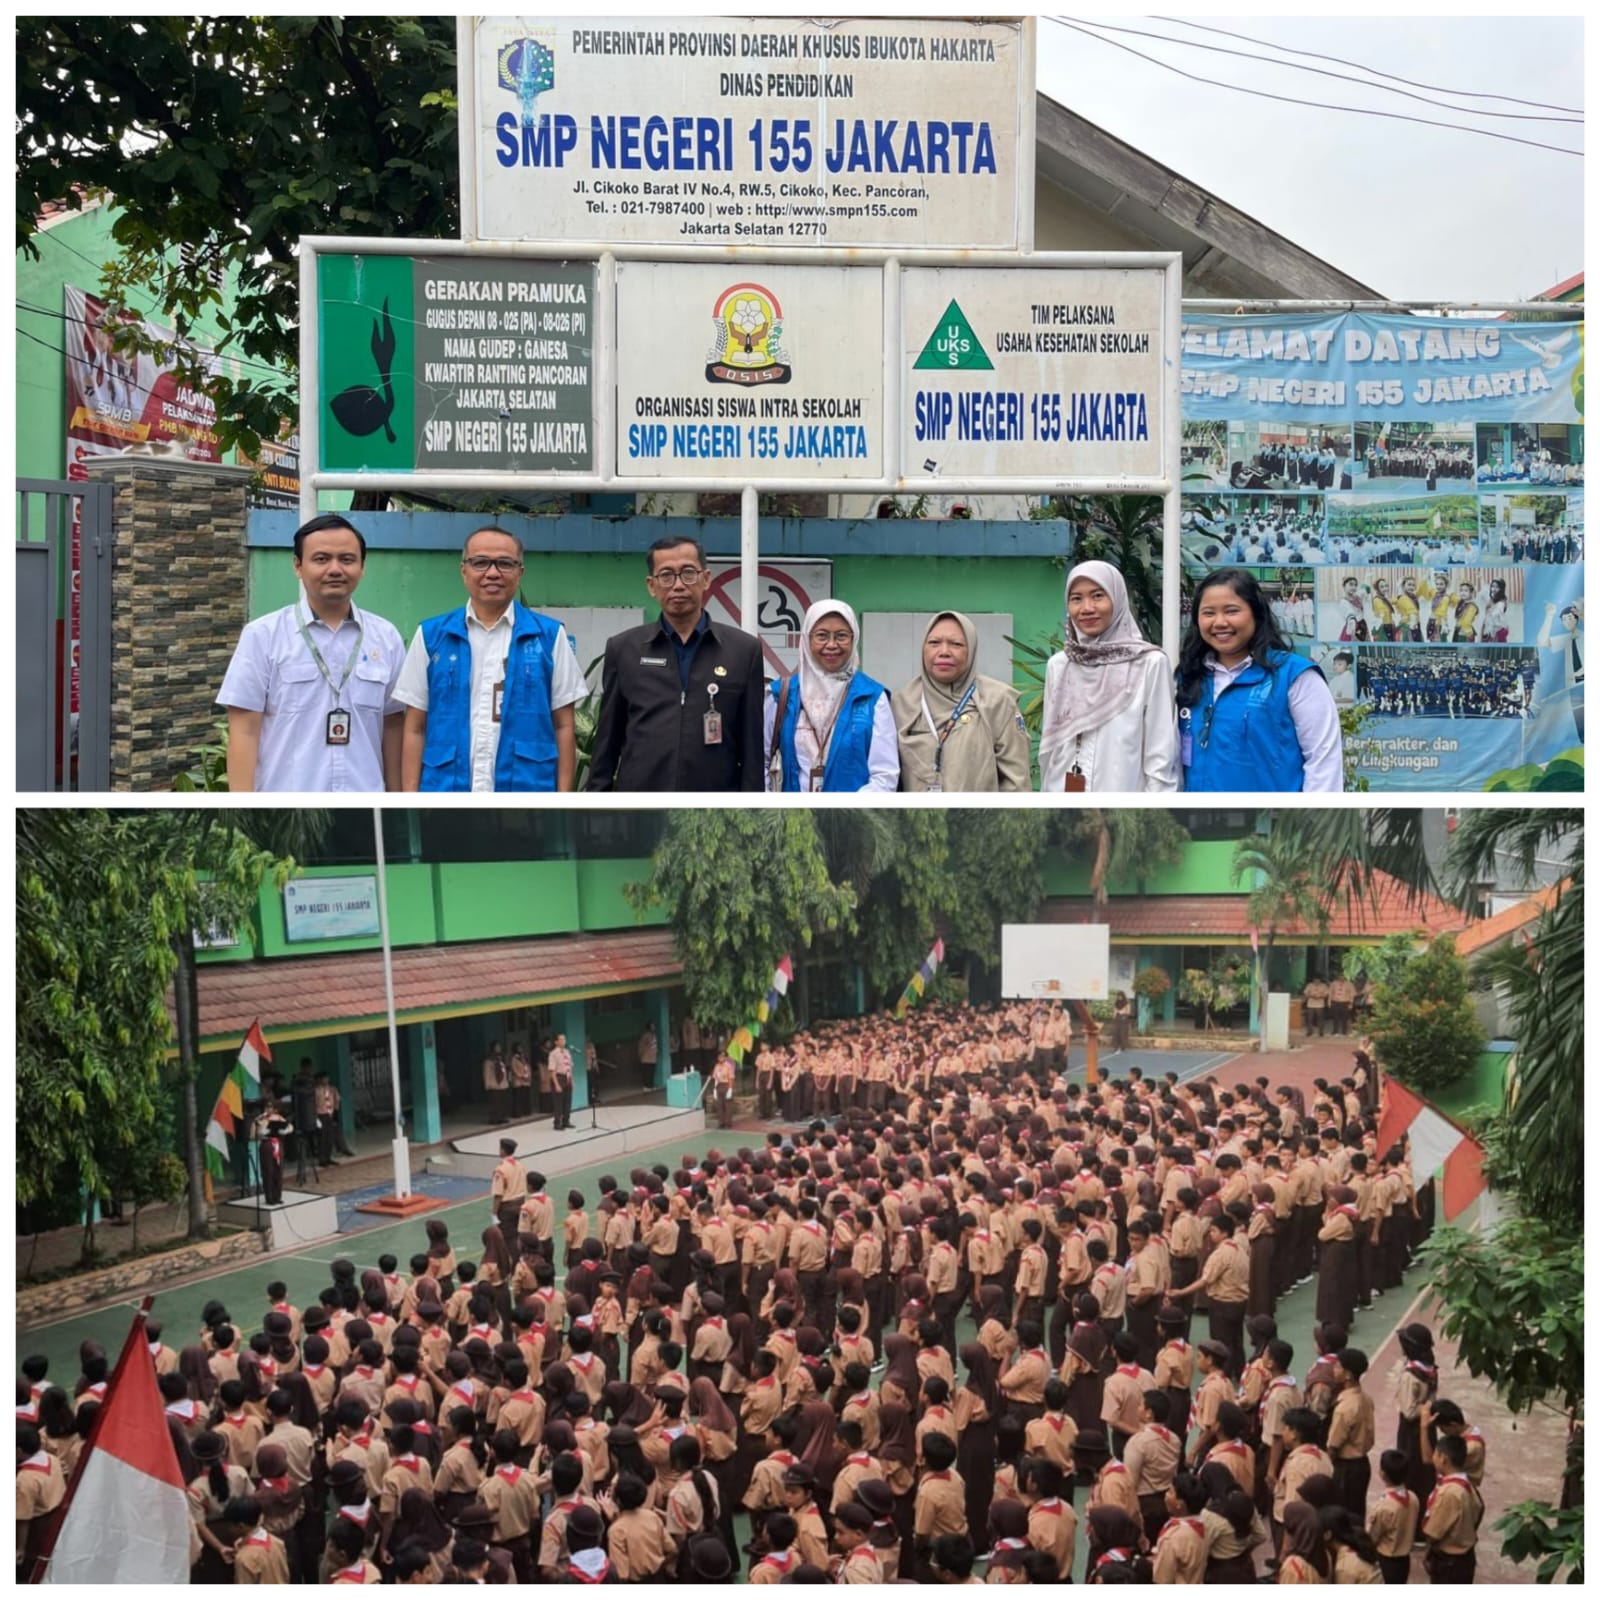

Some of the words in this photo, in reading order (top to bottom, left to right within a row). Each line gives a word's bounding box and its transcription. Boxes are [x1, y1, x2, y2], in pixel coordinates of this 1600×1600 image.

[573, 30, 664, 55] PEMERINTAH
[669, 32, 736, 57] PROVINSI
[741, 34, 798, 58] DAERAH
[803, 35, 860, 59] KHUSUS
[865, 36, 926, 60] IBUKOTA
[931, 38, 995, 62] HAKARTA
[720, 73, 763, 97] DINAS
[767, 73, 853, 98] PENDIDIKAN
[496, 111, 578, 168] SMP
[591, 116, 733, 171] NEGERI
[748, 118, 812, 173] 155
[825, 120, 997, 174] JAKARTA
[573, 181, 589, 193] Jl.
[593, 181, 639, 194] Cikoko
[643, 182, 679, 195] Barat
[683, 183, 697, 195] IV
[701, 183, 735, 198] No.4,
[739, 183, 775, 198] RW.5,
[780, 183, 828, 199] Cikoko,
[832, 184, 861, 197] Kec.
[866, 185, 930, 200] Pancoran,
[586, 201, 608, 213] Tel.
[621, 201, 705, 215] 021-7987400
[716, 203, 743, 215] web
[756, 204, 917, 219] http://www.smpn155.com
[680, 222, 730, 235] Jakarta
[734, 222, 783, 235] Selatan
[788, 223, 827, 235] 12770
[425, 280, 502, 301] GERAKAN
[508, 283, 586, 303] PRAMUKA
[426, 309, 456, 329] GUGUS
[458, 310, 485, 330] DEPAN
[504, 312, 518, 331] 025
[520, 312, 537, 335] (PA)
[572, 313, 585, 336] (PI)
[1031, 305, 1049, 325] TIM
[1052, 305, 1115, 325] PELAKSANA
[444, 338, 476, 358] NAMA
[478, 339, 515, 359] GUDEP
[525, 340, 568, 360] GANESA
[937, 338, 970, 352] UKS
[997, 333, 1032, 352] USAHA
[1036, 333, 1097, 353] KESEHATAN
[1100, 333, 1149, 353] SEKOLAH
[1181, 323, 1335, 362] ELAMAT
[1344, 327, 1500, 362] DATANG
[425, 363, 474, 383] KWARTIR
[477, 364, 525, 384] RANTING
[529, 365, 587, 385] PANCORAN
[726, 369, 774, 382] OSIS
[1181, 369, 1239, 397] SMP
[1249, 377, 1346, 405] NEGERI
[1356, 380, 1403, 406] 155
[1413, 367, 1552, 405] JAKARTA
[456, 389, 506, 408] JAKARTA
[509, 389, 556, 409] SELATAN
[635, 397, 713, 418] ORGANISASI
[717, 398, 756, 418] SISWA
[761, 398, 798, 418] INTRA
[803, 398, 861, 418] SEKOLAH
[915, 390, 953, 441] SMP
[958, 391, 1024, 441] NEGERI
[1031, 393, 1060, 441] 155
[1066, 393, 1148, 441] JAKARTA
[425, 420, 452, 452] SMP
[455, 421, 501, 452] NEGERI
[505, 423, 527, 453] 155
[530, 423, 587, 453] JAKARTA
[628, 424, 667, 458] SMP
[673, 425, 741, 458] NEGERI
[748, 425, 779, 458] 155
[784, 425, 867, 458] JAKARTA
[1433, 737, 1458, 751] dan
